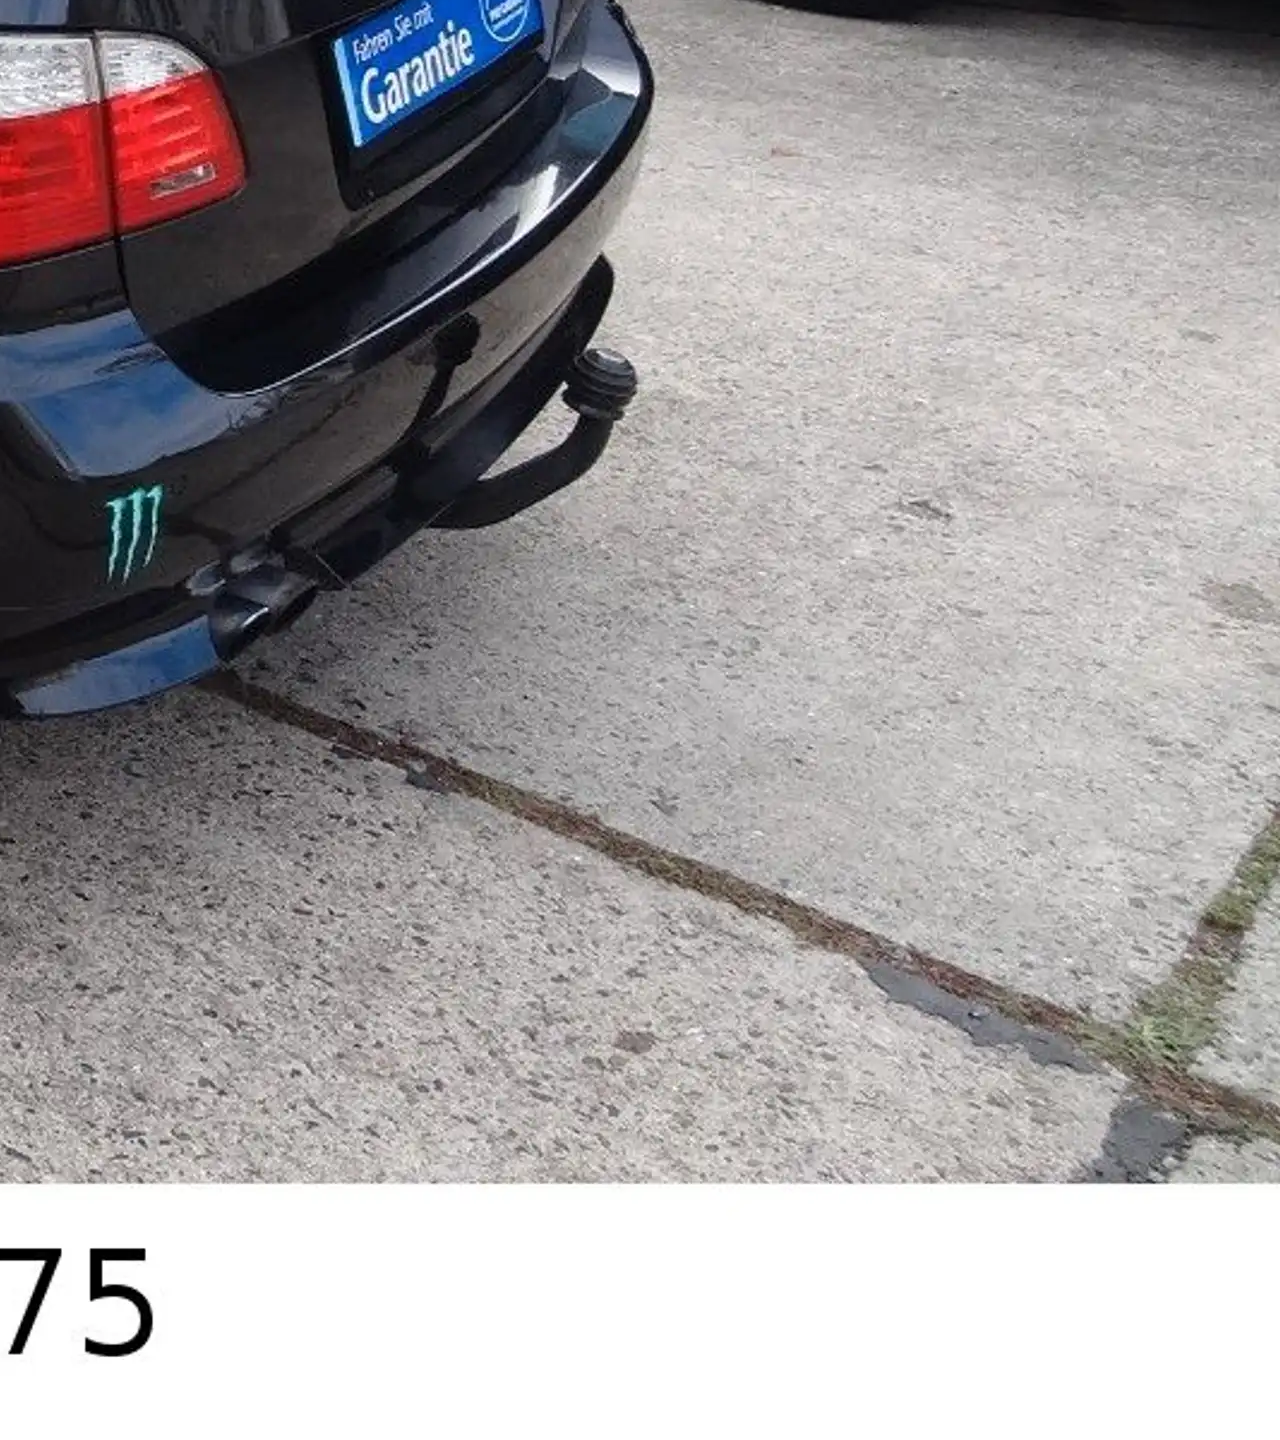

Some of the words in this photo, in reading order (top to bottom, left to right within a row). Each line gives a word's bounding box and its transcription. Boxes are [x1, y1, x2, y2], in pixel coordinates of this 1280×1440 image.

[394, 14, 413, 42] Sie
[413, 0, 435, 30] mit
[361, 19, 475, 124] Garantie
